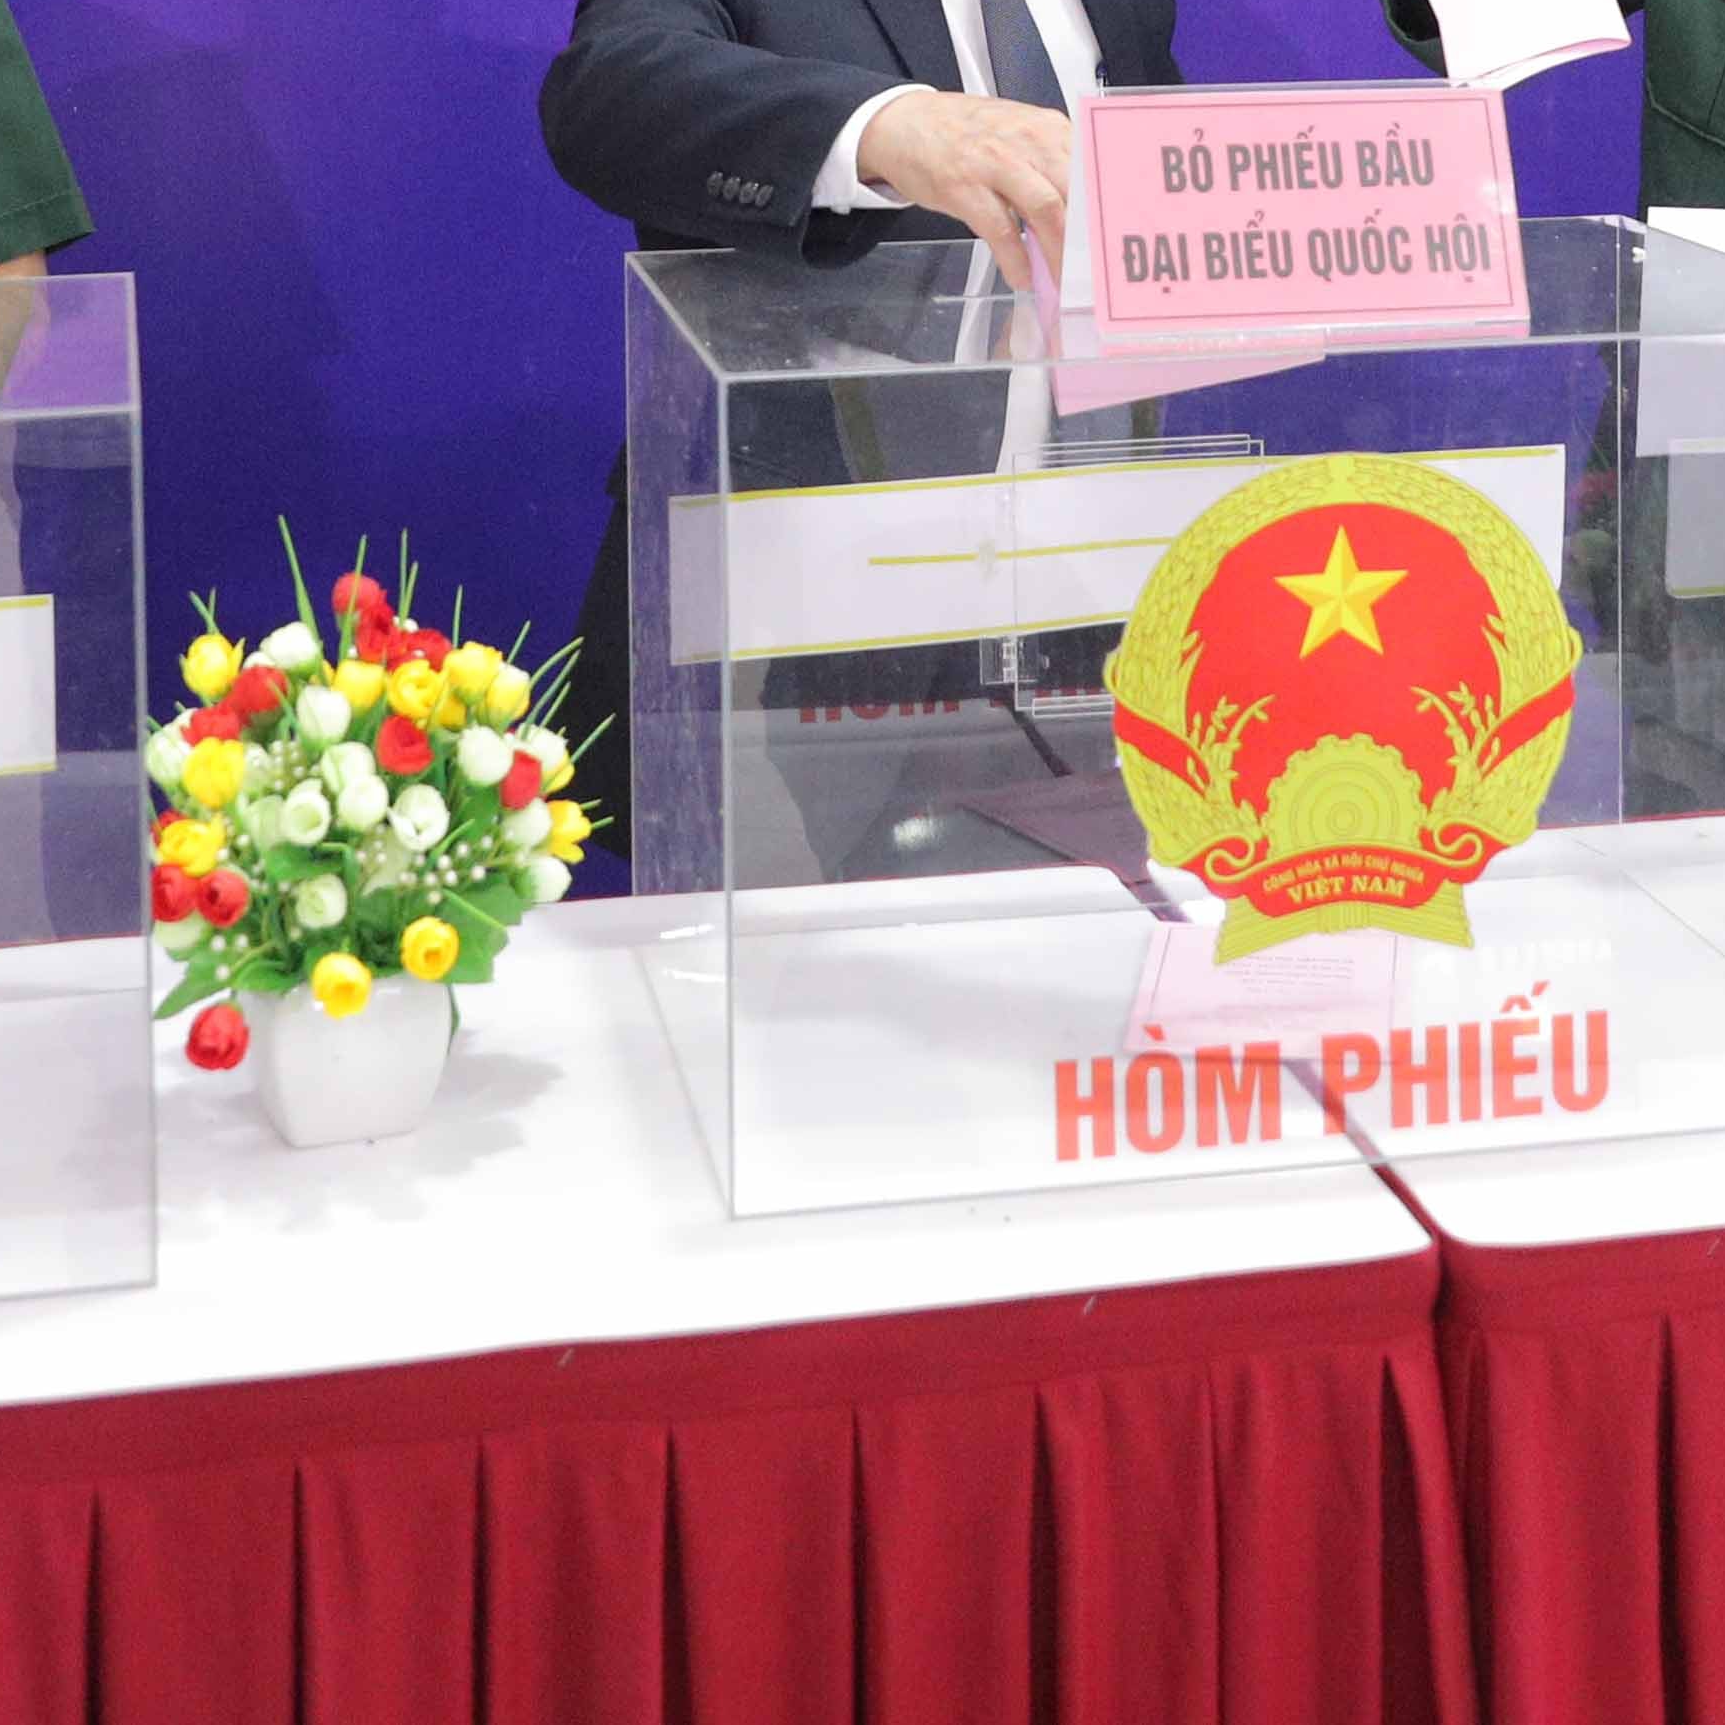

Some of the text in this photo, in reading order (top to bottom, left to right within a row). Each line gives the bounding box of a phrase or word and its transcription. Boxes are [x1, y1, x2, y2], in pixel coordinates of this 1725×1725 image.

[1161, 123, 1435, 193] BỎ PHIẾU BẦU
[1122, 209, 1491, 294] ĐẠI BIỂU QUỐC HỘI
[1287, 876, 1407, 904] VIỆT NAM
[1054, 981, 1610, 1161] HÒM PHIẾU
